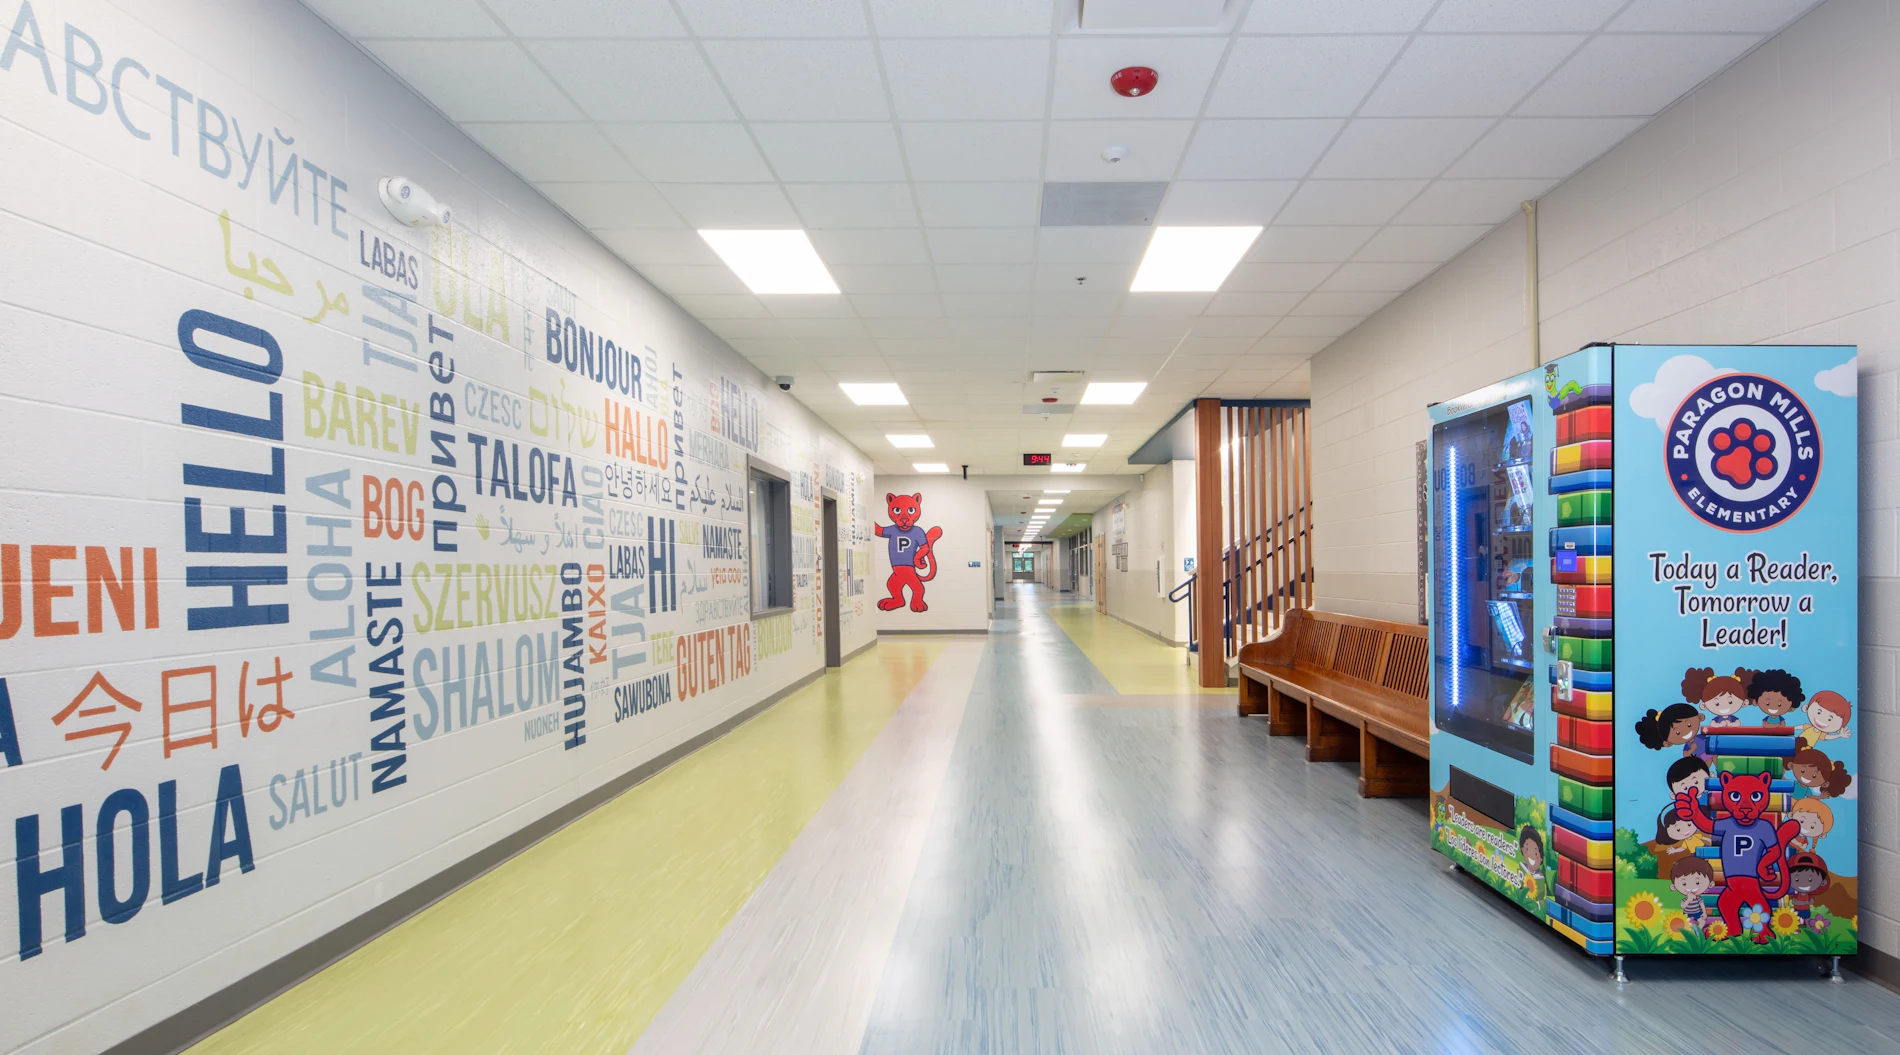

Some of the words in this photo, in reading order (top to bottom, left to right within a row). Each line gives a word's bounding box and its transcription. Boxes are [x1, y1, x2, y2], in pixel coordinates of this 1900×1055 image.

[360, 229, 418, 290] LABAS
[362, 284, 419, 373] TJA
[546, 306, 643, 403] BONJOUR
[302, 370, 420, 456] BAREV
[464, 381, 522, 430] CZESC
[644, 344, 658, 409] AHOJ
[528, 378, 599, 449] שלום
[605, 398, 669, 471] HALLO
[720, 376, 760, 454] HELLO
[1673, 382, 1764, 459] PARAGON
[1769, 392, 1814, 460] MILLS
[177, 308, 290, 631] HELLO
[467, 432, 578, 508] TALOFA
[605, 462, 673, 505] 안녕하세요
[688, 428, 730, 474] MERHABA
[1031, 455, 1050, 464] 9:44
[362, 475, 425, 541] BOG
[581, 464, 605, 550] CIAO
[608, 507, 644, 537] CZESC
[1687, 487, 1798, 523] ELEMENTARY
[305, 468, 357, 688] ALOHA
[609, 545, 645, 580] LABAS
[647, 516, 677, 614] HI
[703, 524, 743, 560] NAMASTE
[897, 536, 911, 553] P
[1649, 552, 1718, 589] Today
[1726, 563, 1740, 580] a
[1747, 552, 1838, 584] Reader,
[412, 561, 559, 636] SZERVUSZ
[587, 563, 608, 665] KAIXO
[611, 584, 647, 680] TJA
[1674, 585, 1791, 615] Tomorrow
[1799, 596, 1812, 613] a
[1702, 618, 1787, 648] Leader!
[366, 562, 407, 794] NAMASTE
[560, 562, 587, 751] HUJAMBO
[650, 631, 674, 667] TERE
[677, 627, 725, 702] GUTEN
[727, 623, 751, 682] TAG
[50, 656, 296, 771] 今日は
[412, 631, 561, 741] SHALOM
[614, 672, 672, 724] SAWUBONA
[268, 752, 364, 832] SALUT
[15, 763, 256, 962] HOLA
[1475, 825, 1487, 841] are
[1734, 834, 1754, 856] P
